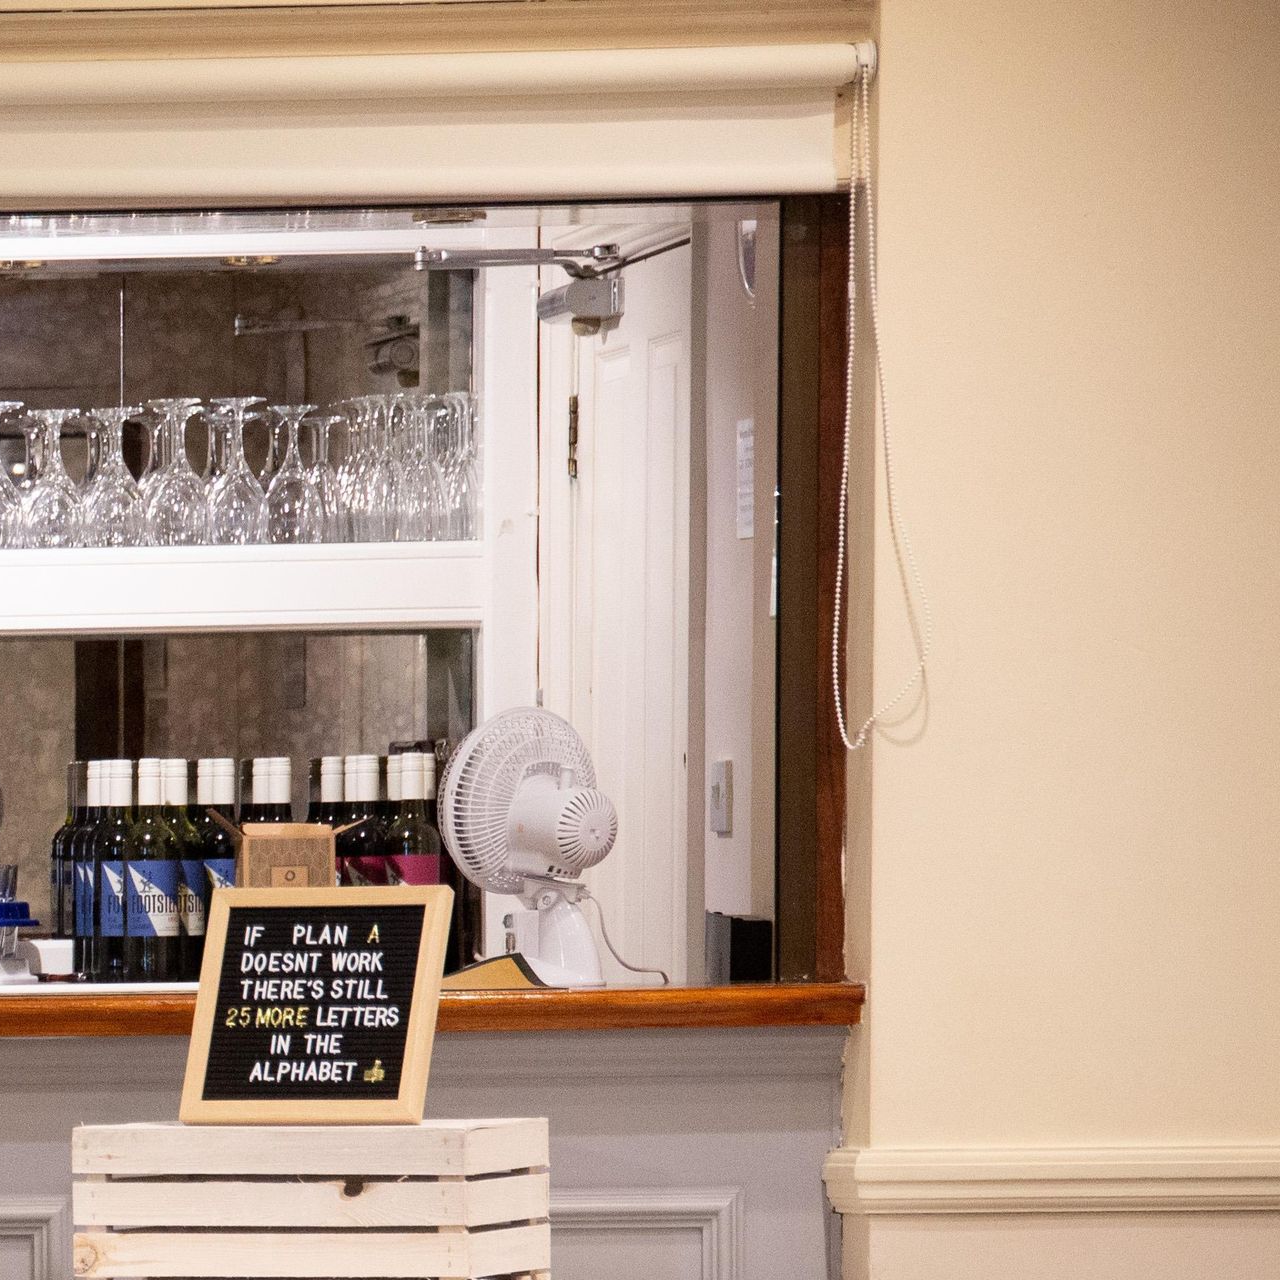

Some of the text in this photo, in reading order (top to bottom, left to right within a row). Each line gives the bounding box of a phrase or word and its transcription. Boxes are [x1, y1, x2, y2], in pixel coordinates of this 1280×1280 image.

[243, 924, 380, 947] IF PLAN A
[240, 952, 383, 974] DOESNT WORK
[240, 980, 389, 1000] THERE'S STILL
[225, 1006, 400, 1028] 25 MORE LETTERS
[270, 1034, 344, 1056] IN THE
[249, 1062, 358, 1083] ALPHABET
